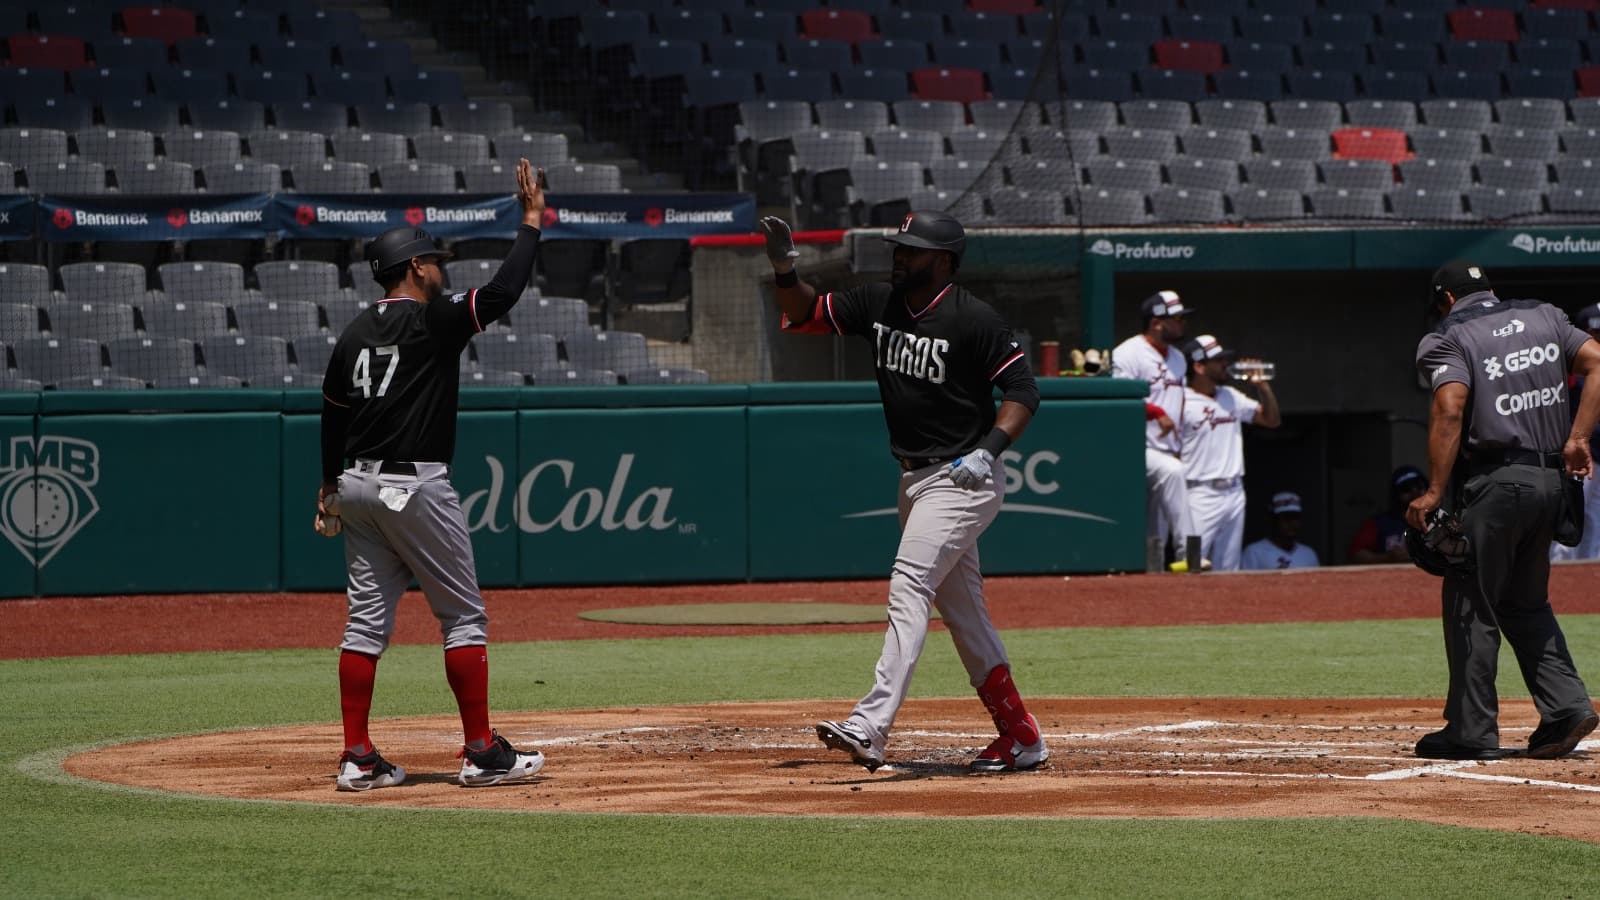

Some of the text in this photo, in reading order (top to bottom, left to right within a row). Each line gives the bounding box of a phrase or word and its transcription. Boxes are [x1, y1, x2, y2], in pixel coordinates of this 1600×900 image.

[76, 210, 148, 226] Banamex
[189, 208, 262, 224] Banamex
[317, 206, 387, 223] Banamex
[426, 206, 496, 223] Banamex
[558, 207, 627, 223] Banamex
[665, 207, 733, 223] Banamex
[1115, 242, 1195, 259] Profuturo
[873, 321, 950, 385] TOROS
[1504, 342, 1560, 373] G500
[352, 344, 400, 399] 47
[1495, 381, 1565, 416] Comex
[513, 453, 677, 534] Cola
